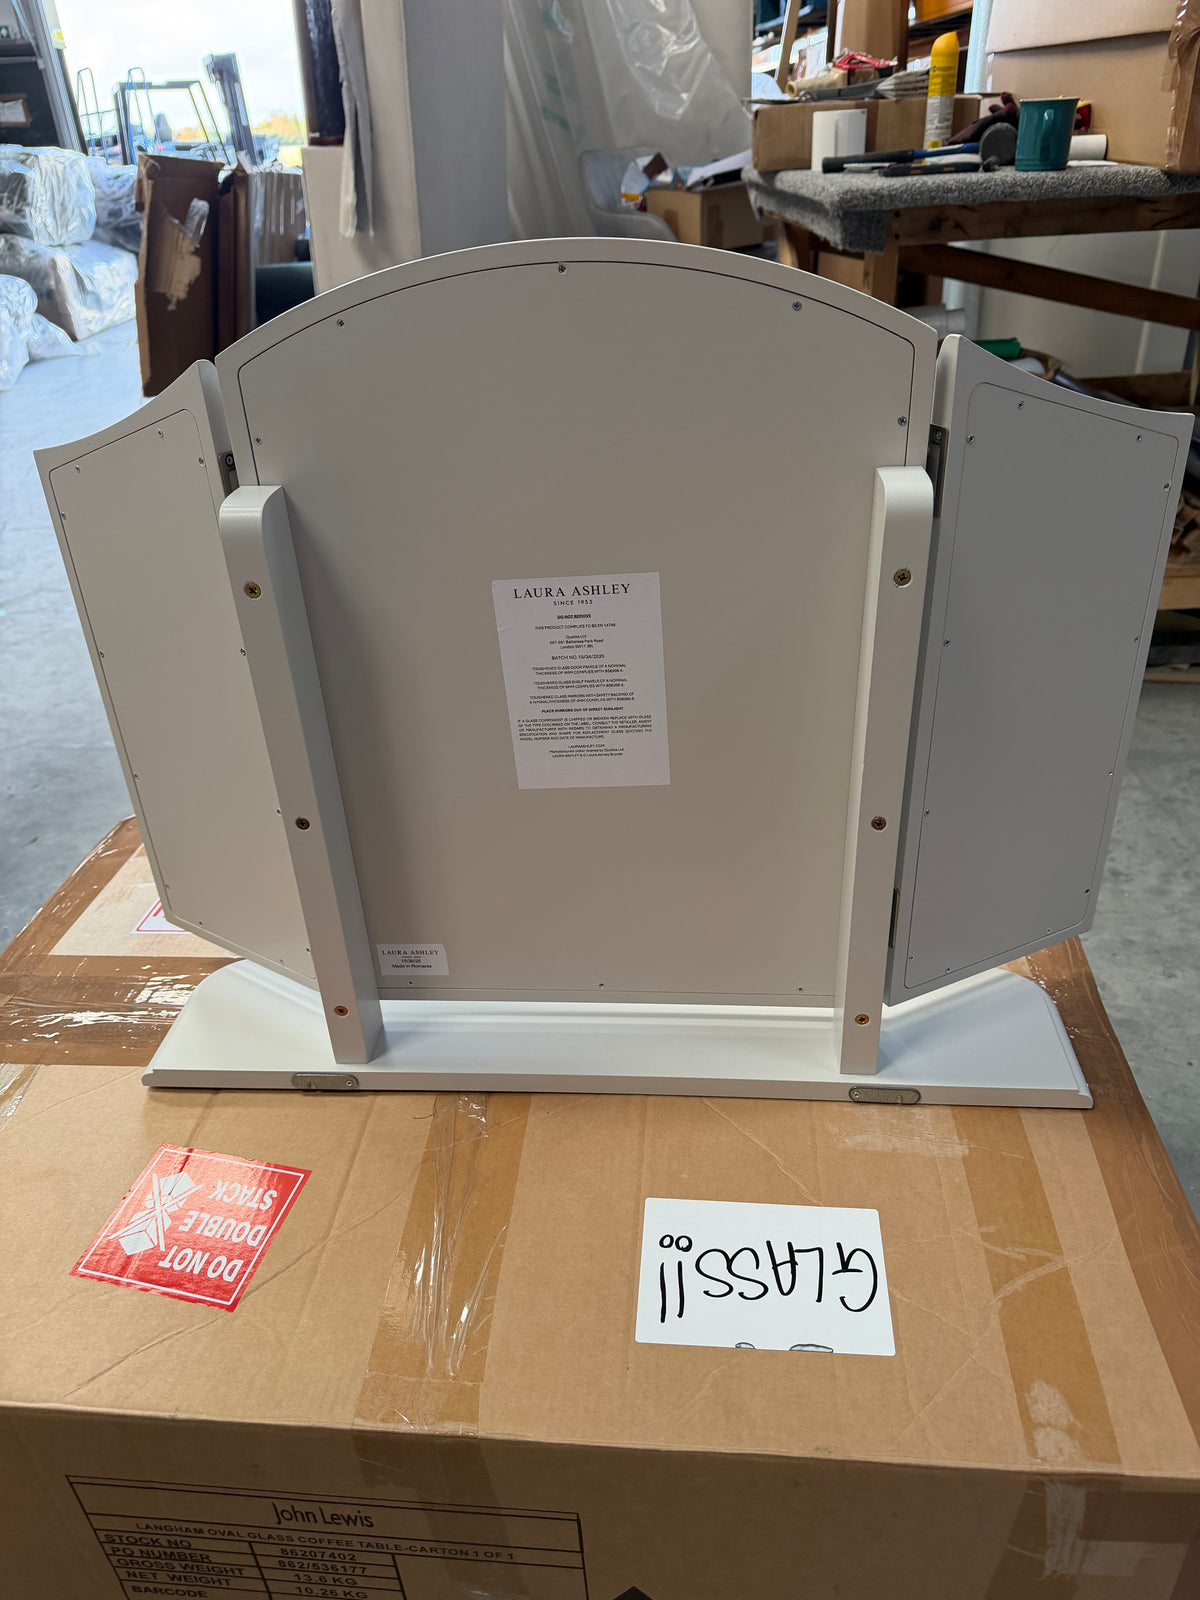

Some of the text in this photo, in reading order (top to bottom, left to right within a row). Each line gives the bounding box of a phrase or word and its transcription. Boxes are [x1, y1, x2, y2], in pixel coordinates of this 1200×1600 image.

[513, 584, 630, 598] LAURA ASHLEY
[208, 1180, 277, 1210] STACK
[178, 1210, 267, 1247] DOUBLE
[158, 1246, 244, 1282] DO NOT
[272, 1502, 374, 1528] John Lewis
[104, 1534, 357, 1561] STOCK NO 86207402
[136, 1523, 204, 1535] LANGHAM
[208, 1529, 243, 1538] OVAL
[248, 1532, 293, 1542] GLASS
[298, 1536, 354, 1547] COFFEE
[357, 1541, 469, 1556] TABLE-CARTON
[111, 1547, 367, 1574] PO NUMBER 862/536177
[117, 1558, 357, 1586] GROSS WEIGHT 13.6 KG
[126, 1571, 368, 1599] NET WEIGHT 10.26 KG
[131, 1585, 208, 1598] BARCODE
